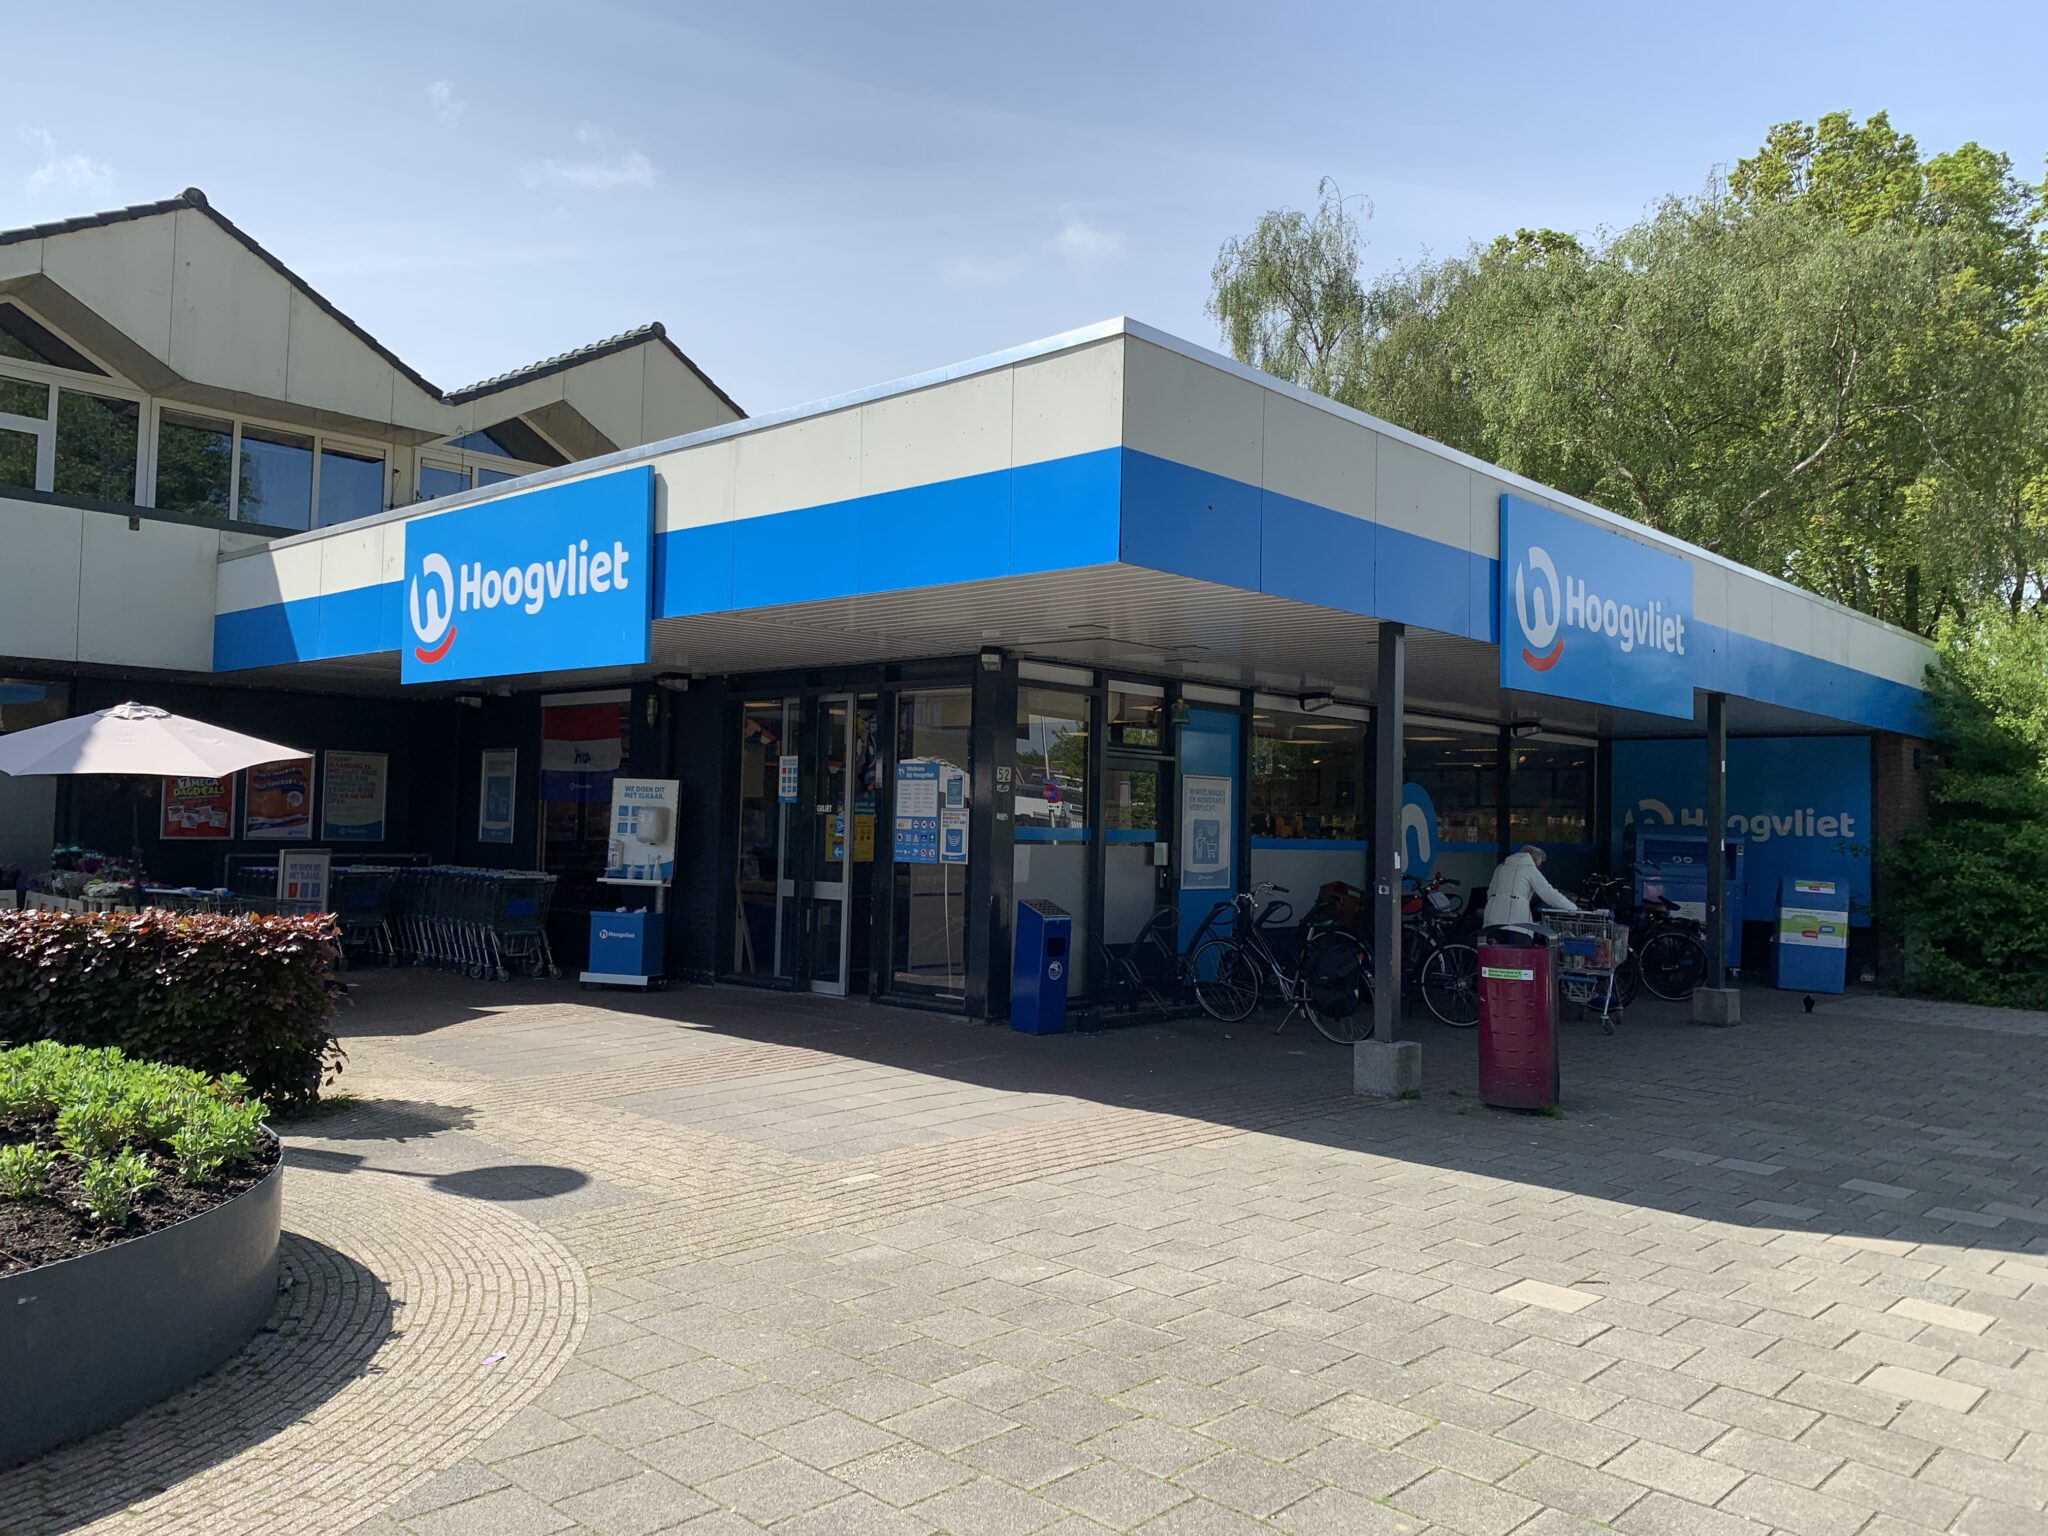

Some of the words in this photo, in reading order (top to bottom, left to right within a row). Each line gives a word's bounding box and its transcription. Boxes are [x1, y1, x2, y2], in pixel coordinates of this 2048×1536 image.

[459, 539, 629, 615] Hoogvliet
[1566, 575, 1685, 656] Hoogvliet
[191, 779, 219, 787] MEGA
[998, 768, 1010, 781] 52
[173, 786, 225, 797] DAGDEALS
[1681, 808, 1855, 842] Hogvliet
